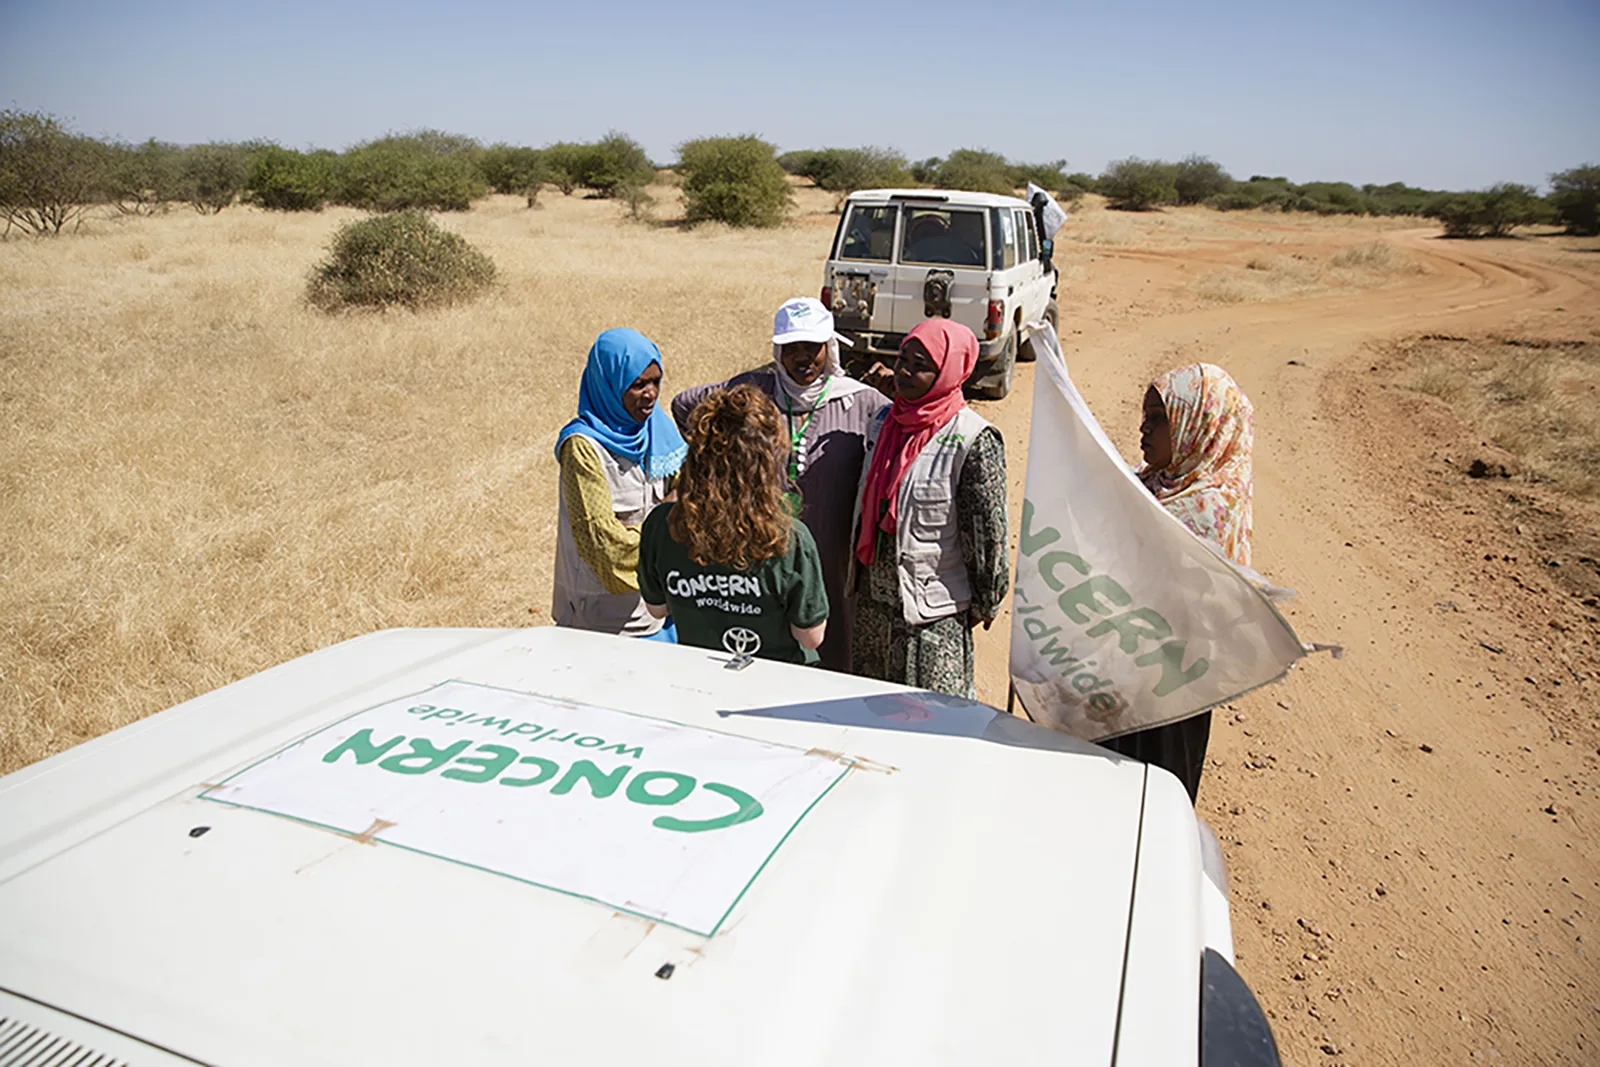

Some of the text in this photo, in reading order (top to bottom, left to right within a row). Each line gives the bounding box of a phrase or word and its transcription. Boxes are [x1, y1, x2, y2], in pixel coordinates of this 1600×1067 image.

[665, 570, 762, 597] CONCERN
[696, 597, 762, 615] worldwide
[1014, 567, 1118, 711] rldwide
[406, 703, 645, 760] worldwide
[321, 727, 765, 833] CONCERN
